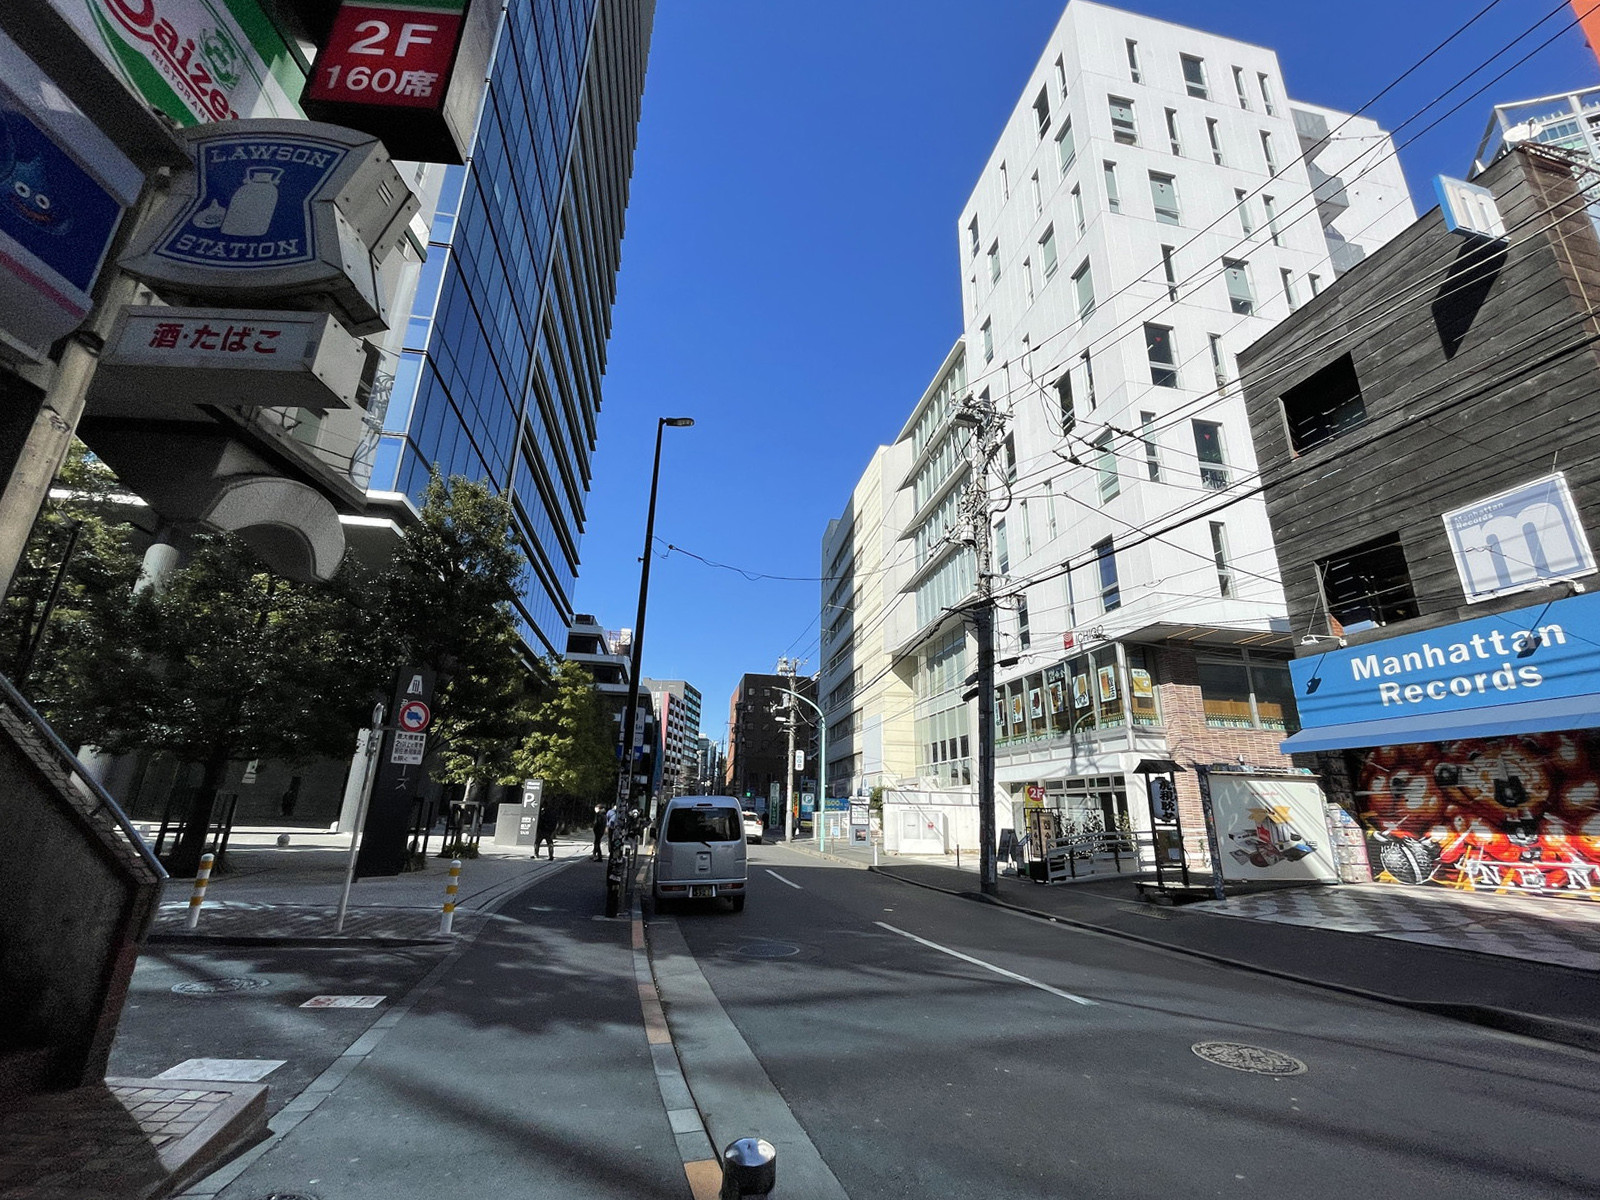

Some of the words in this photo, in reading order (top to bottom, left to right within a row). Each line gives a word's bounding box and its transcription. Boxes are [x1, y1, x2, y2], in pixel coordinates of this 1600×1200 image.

[347, 20, 438, 57] 2F
[326, 65, 438, 98] 160席
[210, 145, 332, 168] LAWSON
[176, 237, 299, 260] STATION
[1454, 502, 1504, 523] Manhattan
[1456, 513, 1494, 529] Records
[1350, 623, 1566, 681] Manhattan
[1379, 662, 1544, 707] Records
[523, 792, 535, 808] P
[1029, 787, 1044, 799] 2F
